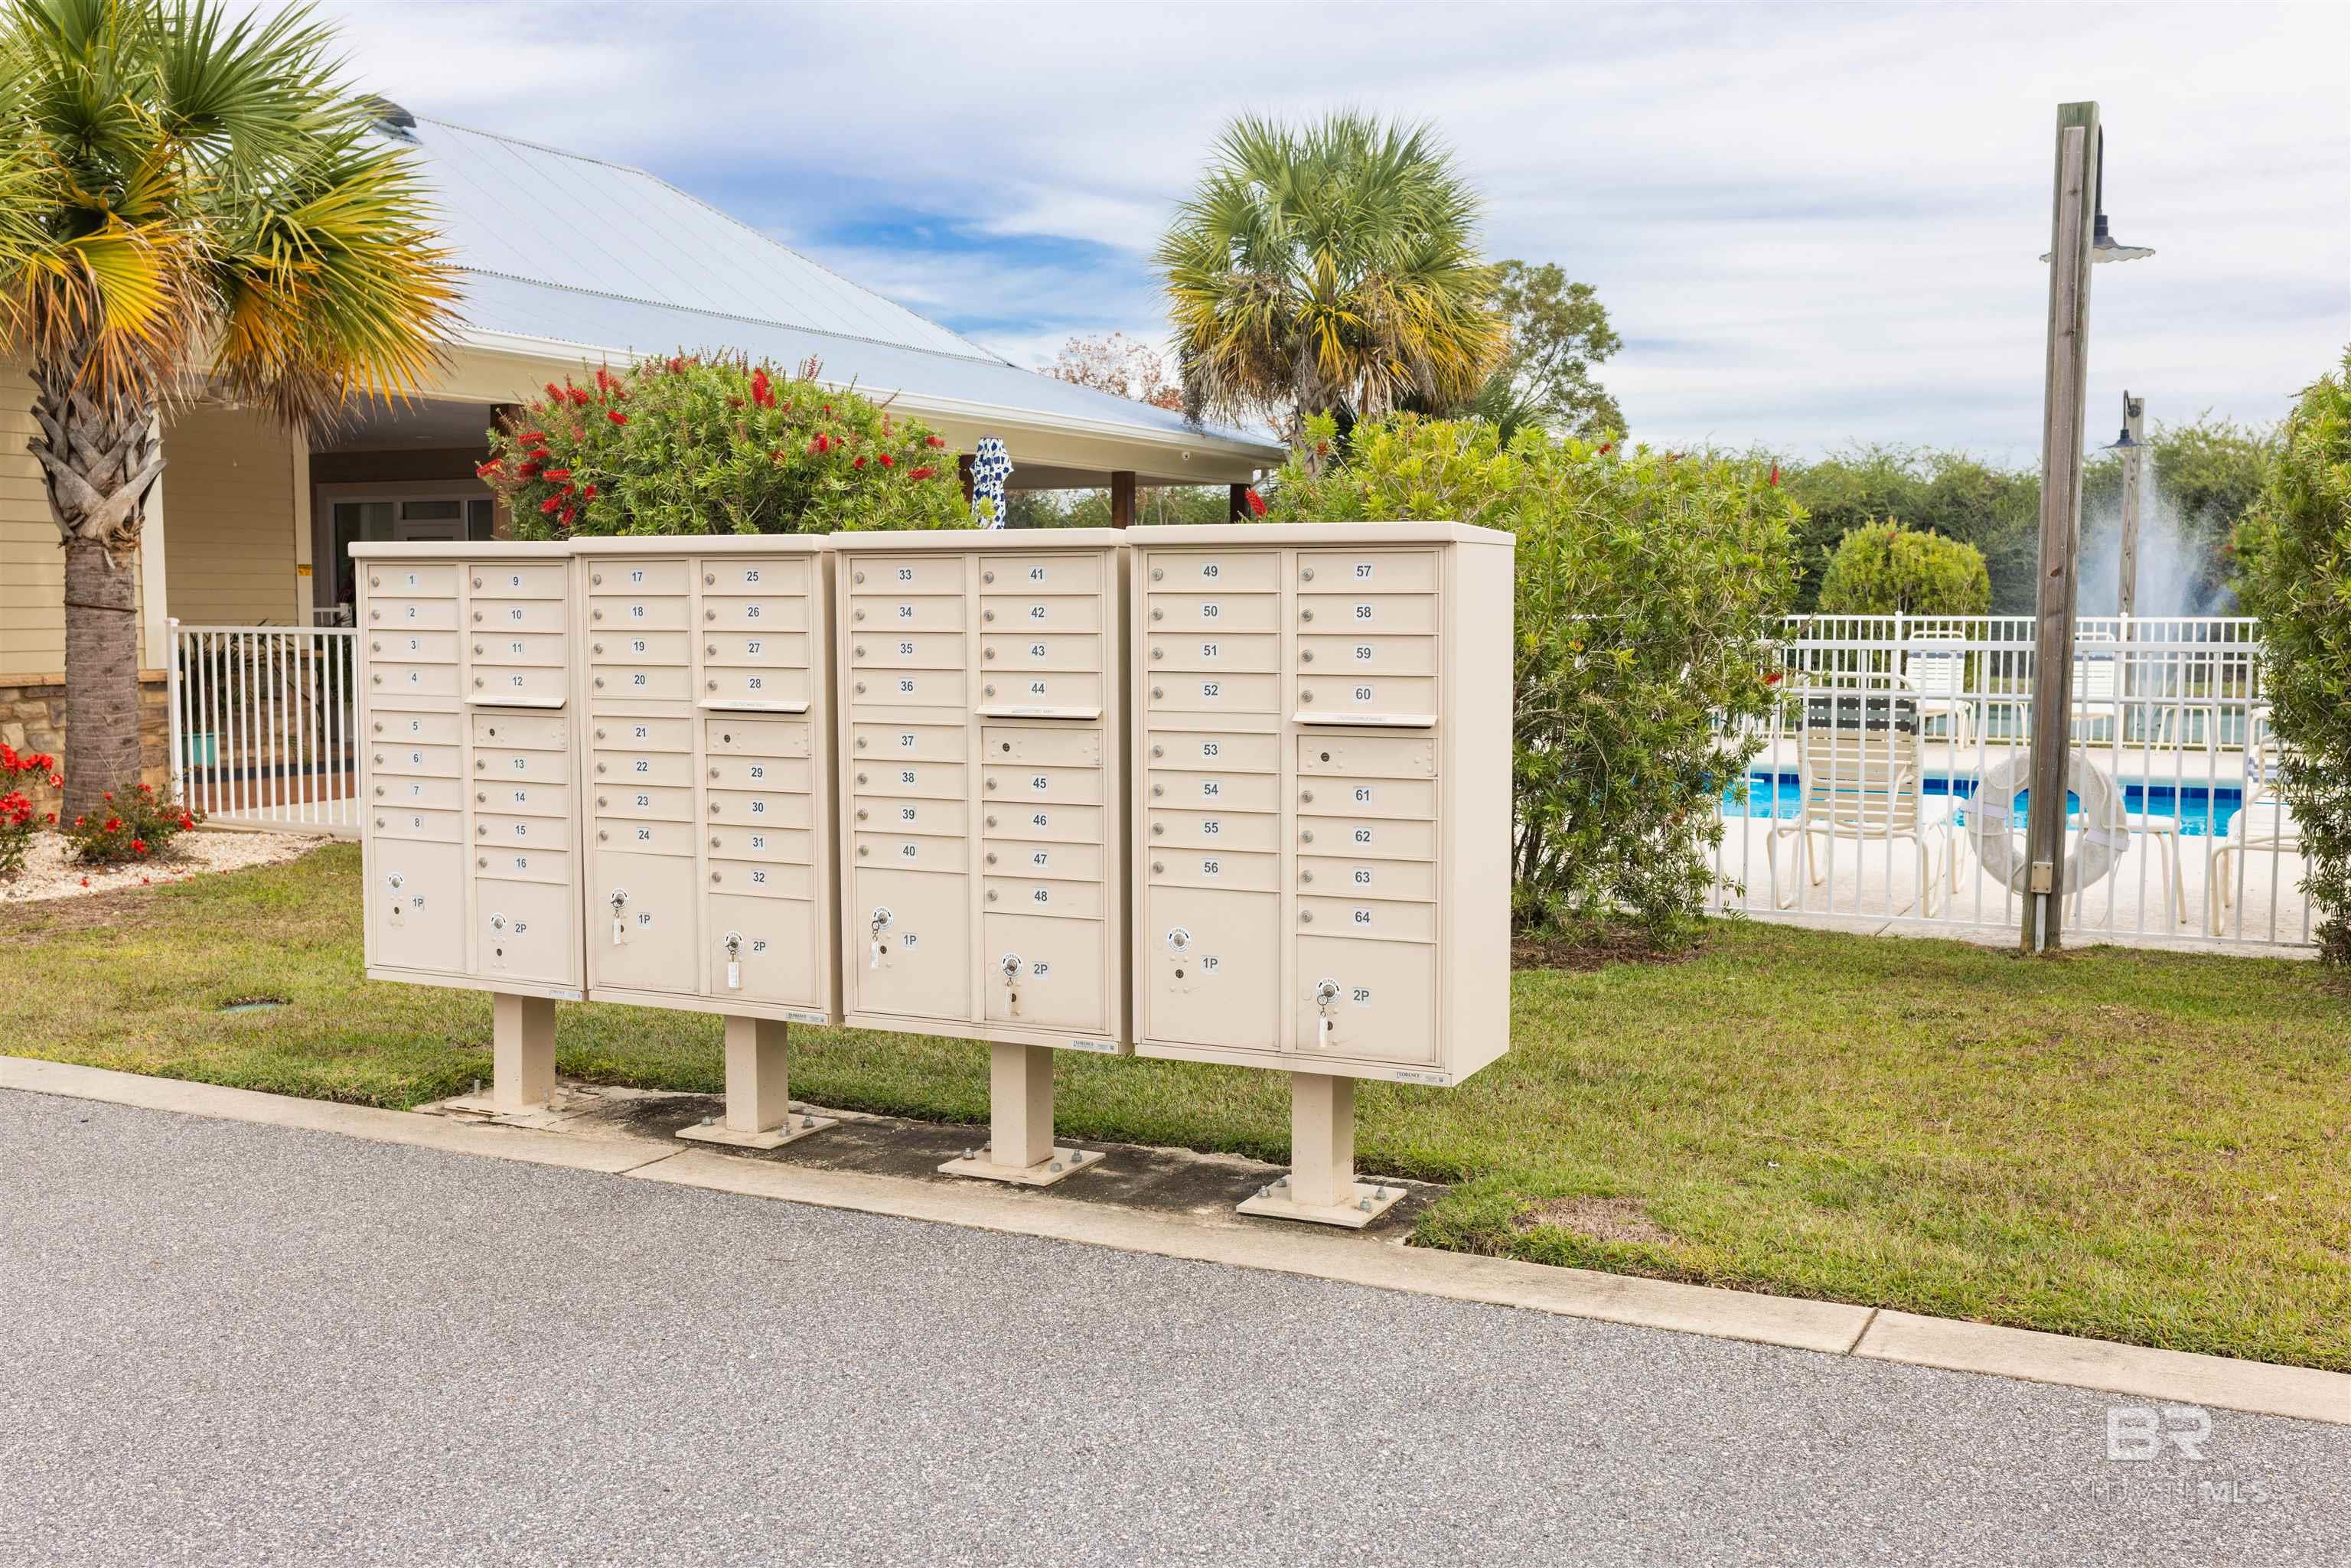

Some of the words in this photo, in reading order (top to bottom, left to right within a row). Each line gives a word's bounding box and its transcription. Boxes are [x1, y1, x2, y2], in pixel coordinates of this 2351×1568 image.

[746, 571, 759, 582] 25
[899, 569, 912, 580] 33
[1030, 569, 1042, 580] 41
[1203, 565, 1218, 577] 49
[1357, 565, 1371, 577] 57
[513, 576, 519, 586] 9
[632, 572, 643, 582] 17
[409, 608, 416, 618] 2
[511, 609, 522, 619] 10
[632, 606, 644, 617] 18
[748, 606, 760, 617] 26
[899, 606, 912, 618] 34
[1031, 607, 1045, 618] 42
[1203, 605, 1218, 617] 50
[1356, 606, 1371, 618] 58
[411, 640, 416, 650] 3
[513, 643, 522, 653] 11
[634, 641, 644, 651] 19
[748, 643, 760, 654] 27
[900, 643, 913, 654] 35
[1204, 644, 1217, 657] 51
[1032, 645, 1045, 657] 43
[1356, 647, 1371, 659] 59
[412, 673, 417, 682] 4
[513, 676, 523, 686] 12
[634, 674, 645, 685] 20
[749, 678, 761, 689] 28
[901, 680, 914, 692] 36
[1031, 683, 1045, 694] 44
[1204, 684, 1218, 696] 52
[1355, 688, 1371, 699] 60
[412, 721, 418, 731] 5
[636, 727, 646, 738] 21
[902, 735, 914, 746] 37
[1204, 744, 1218, 755] 53
[413, 753, 419, 763] 6
[514, 758, 524, 769] 13
[637, 761, 647, 771] 22
[752, 767, 763, 777] 29
[902, 771, 915, 783] 38
[1032, 777, 1047, 789] 45
[414, 786, 419, 795] 7
[1204, 784, 1218, 795] 54
[1355, 789, 1369, 801] 61
[515, 792, 525, 802] 14
[637, 795, 649, 806] 23
[752, 801, 764, 813] 30
[902, 808, 915, 820] 39
[415, 817, 420, 827] 8
[1033, 814, 1047, 826] 46
[515, 825, 526, 835] 15
[1204, 822, 1218, 833] 55
[638, 830, 650, 840] 24
[1355, 830, 1371, 843] 62
[752, 837, 763, 847] 31
[902, 845, 915, 856] 40
[516, 858, 527, 868] 16
[1033, 853, 1048, 864] 47
[1205, 862, 1218, 873] 56
[753, 872, 765, 883] 32
[1355, 871, 1370, 883] 63
[1034, 890, 1048, 901] 48
[412, 898, 423, 907] 1P
[638, 914, 651, 924] 1P
[1355, 911, 1371, 923] 64
[515, 923, 527, 933] 2P
[904, 934, 917, 946] 1P
[753, 941, 766, 951] 2P
[1203, 957, 1218, 969] 1P
[1034, 963, 1048, 975] 2P
[1353, 989, 1370, 1002] 2P
